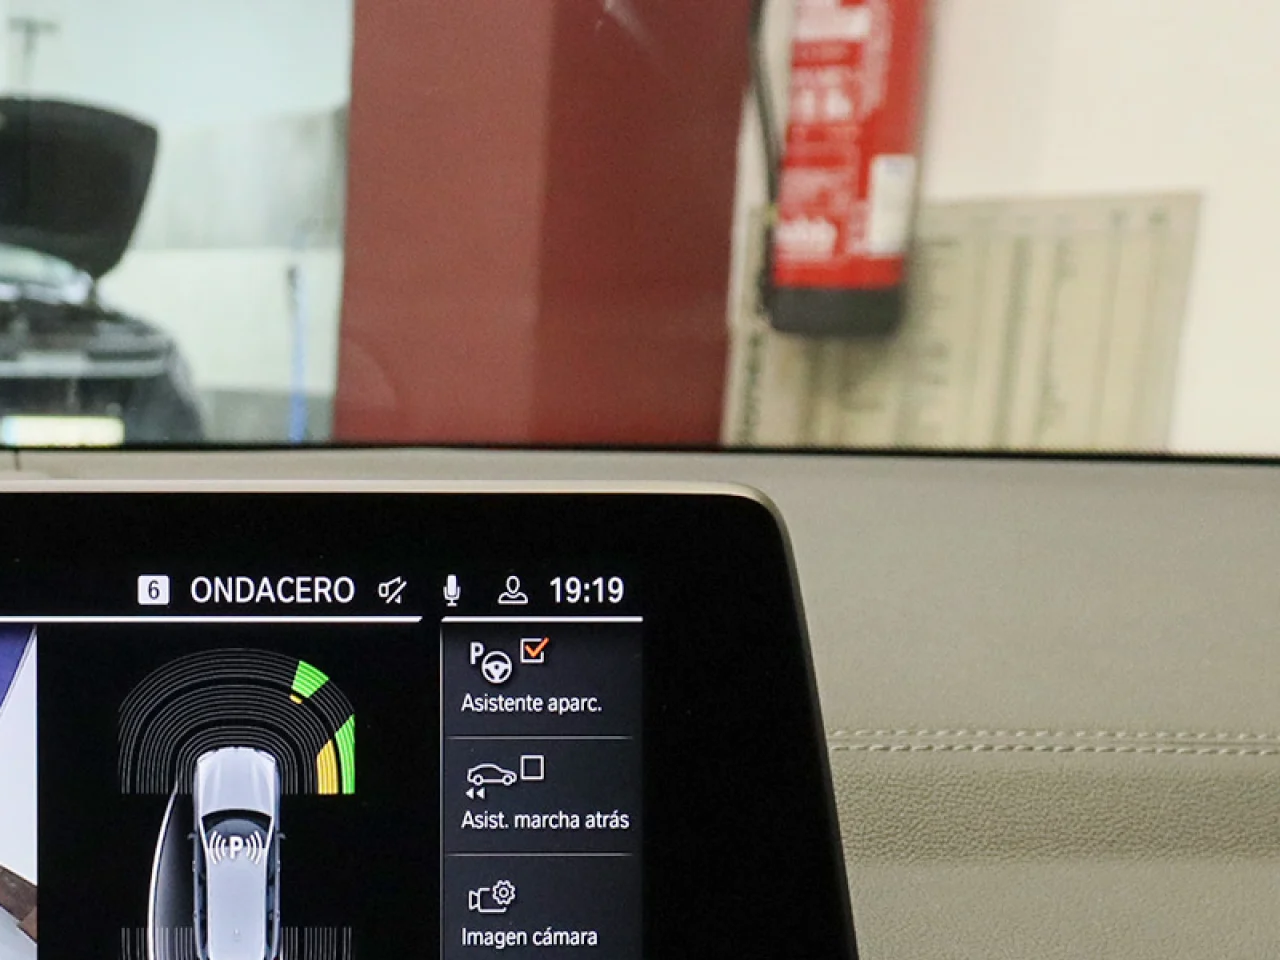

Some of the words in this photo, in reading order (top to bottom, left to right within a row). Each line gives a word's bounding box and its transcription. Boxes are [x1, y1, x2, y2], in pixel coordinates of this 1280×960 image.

[147, 580, 160, 600] 6
[190, 576, 356, 603] ONDACERO
[549, 576, 625, 604] 19:19
[470, 642, 485, 665] P
[461, 693, 544, 712] Asistente
[548, 696, 603, 715] aparc.
[461, 810, 510, 829] Asist.
[514, 811, 580, 829] marcha
[585, 809, 631, 829] atrás
[229, 836, 244, 859] P
[461, 927, 528, 950] Imagen
[532, 926, 598, 946] cámara
